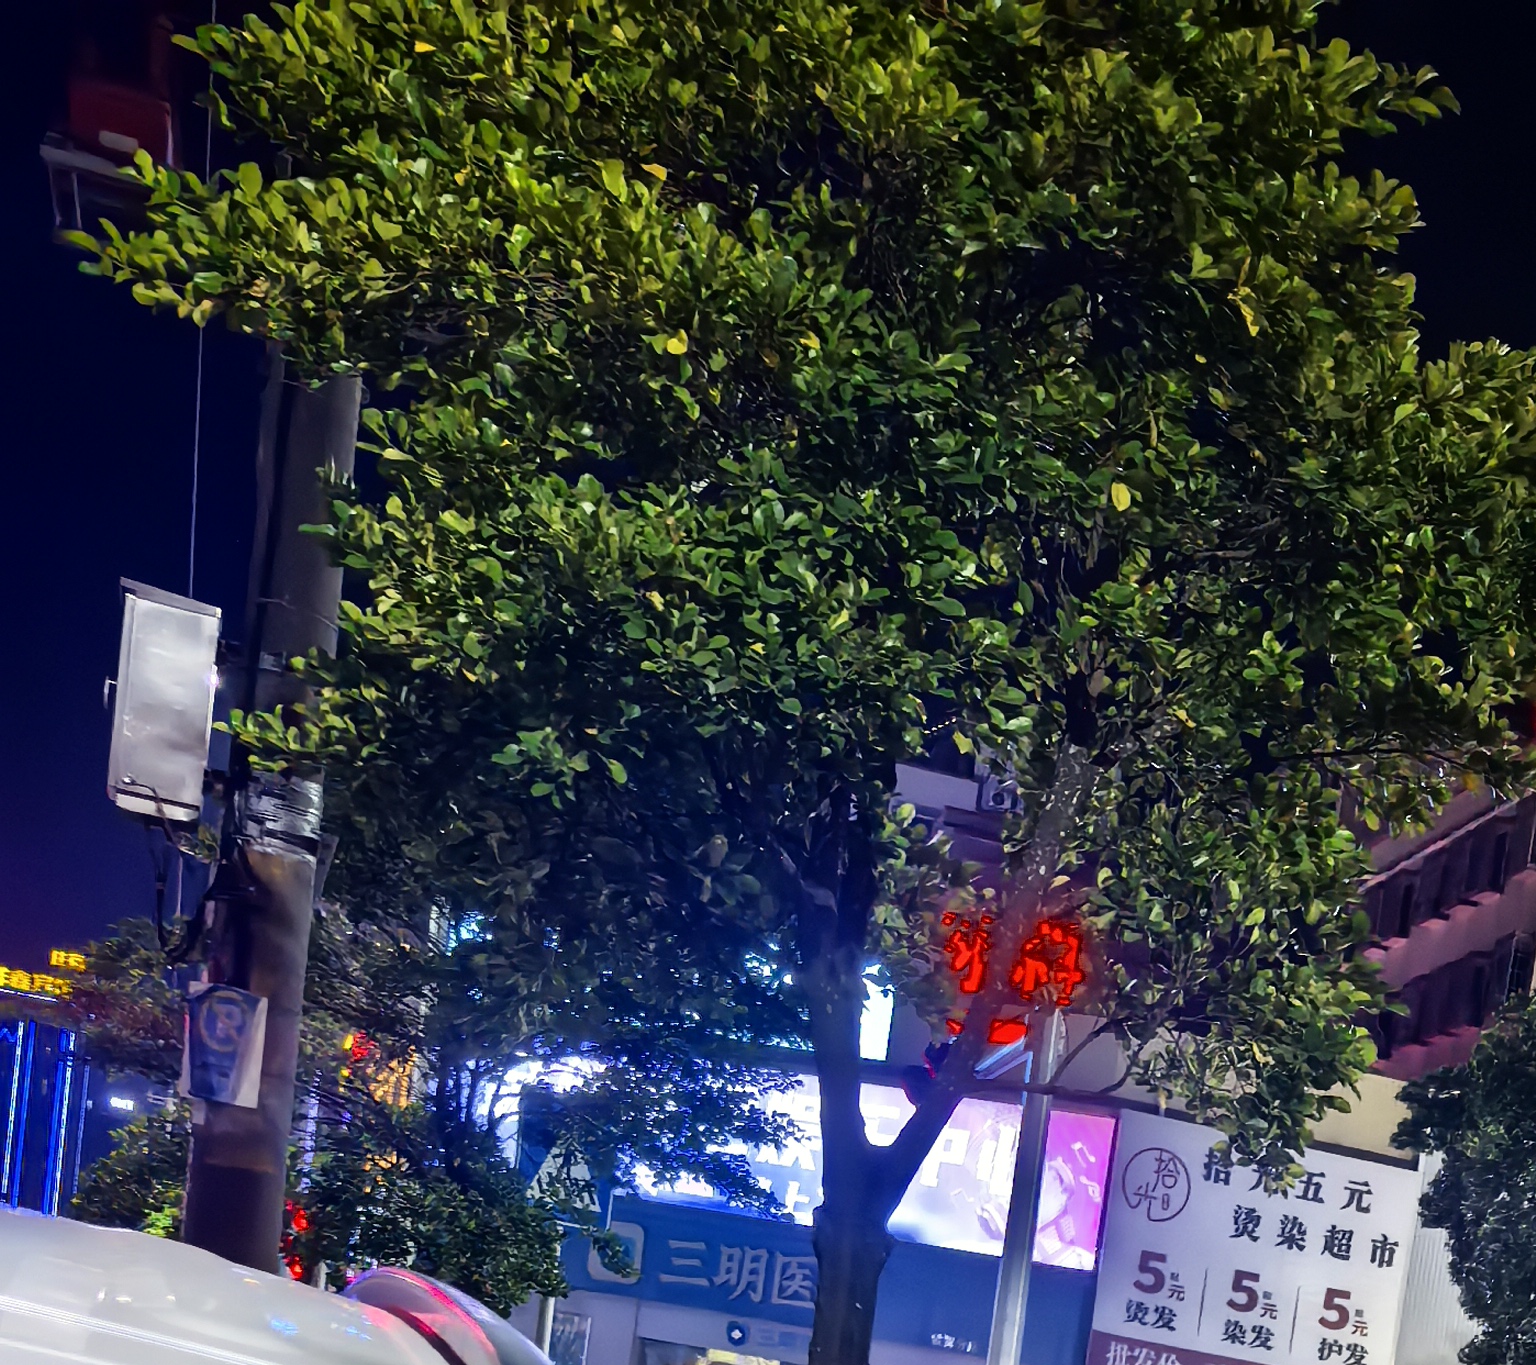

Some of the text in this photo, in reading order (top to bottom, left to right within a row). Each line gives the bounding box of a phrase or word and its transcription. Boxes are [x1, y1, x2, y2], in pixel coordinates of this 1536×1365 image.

[1229, 1204, 1399, 1268] 烫染超市
[1123, 1299, 1178, 1333] 烫发
[1221, 1319, 1275, 1352] 染发
